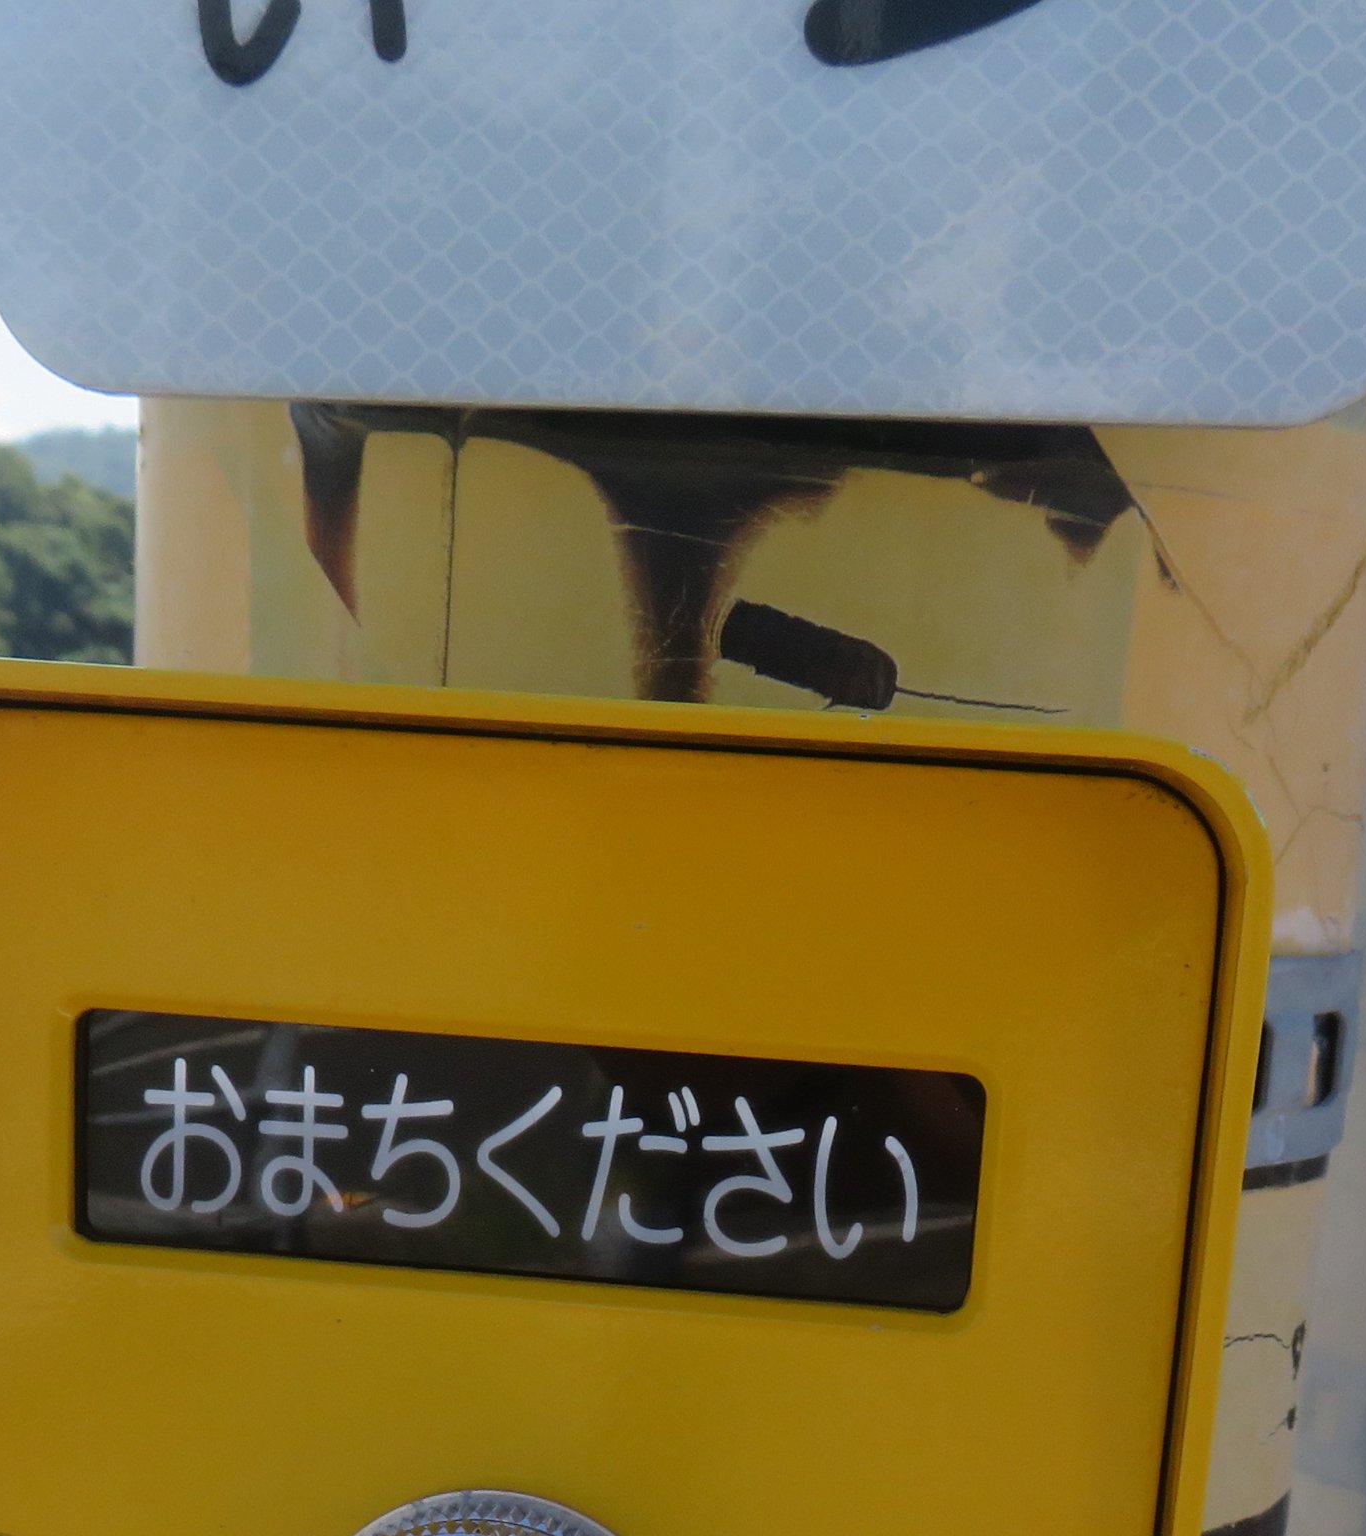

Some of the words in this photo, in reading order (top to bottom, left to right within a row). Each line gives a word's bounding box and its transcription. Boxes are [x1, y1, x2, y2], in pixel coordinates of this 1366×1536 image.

[140, 1057, 919, 1258] おまちください
